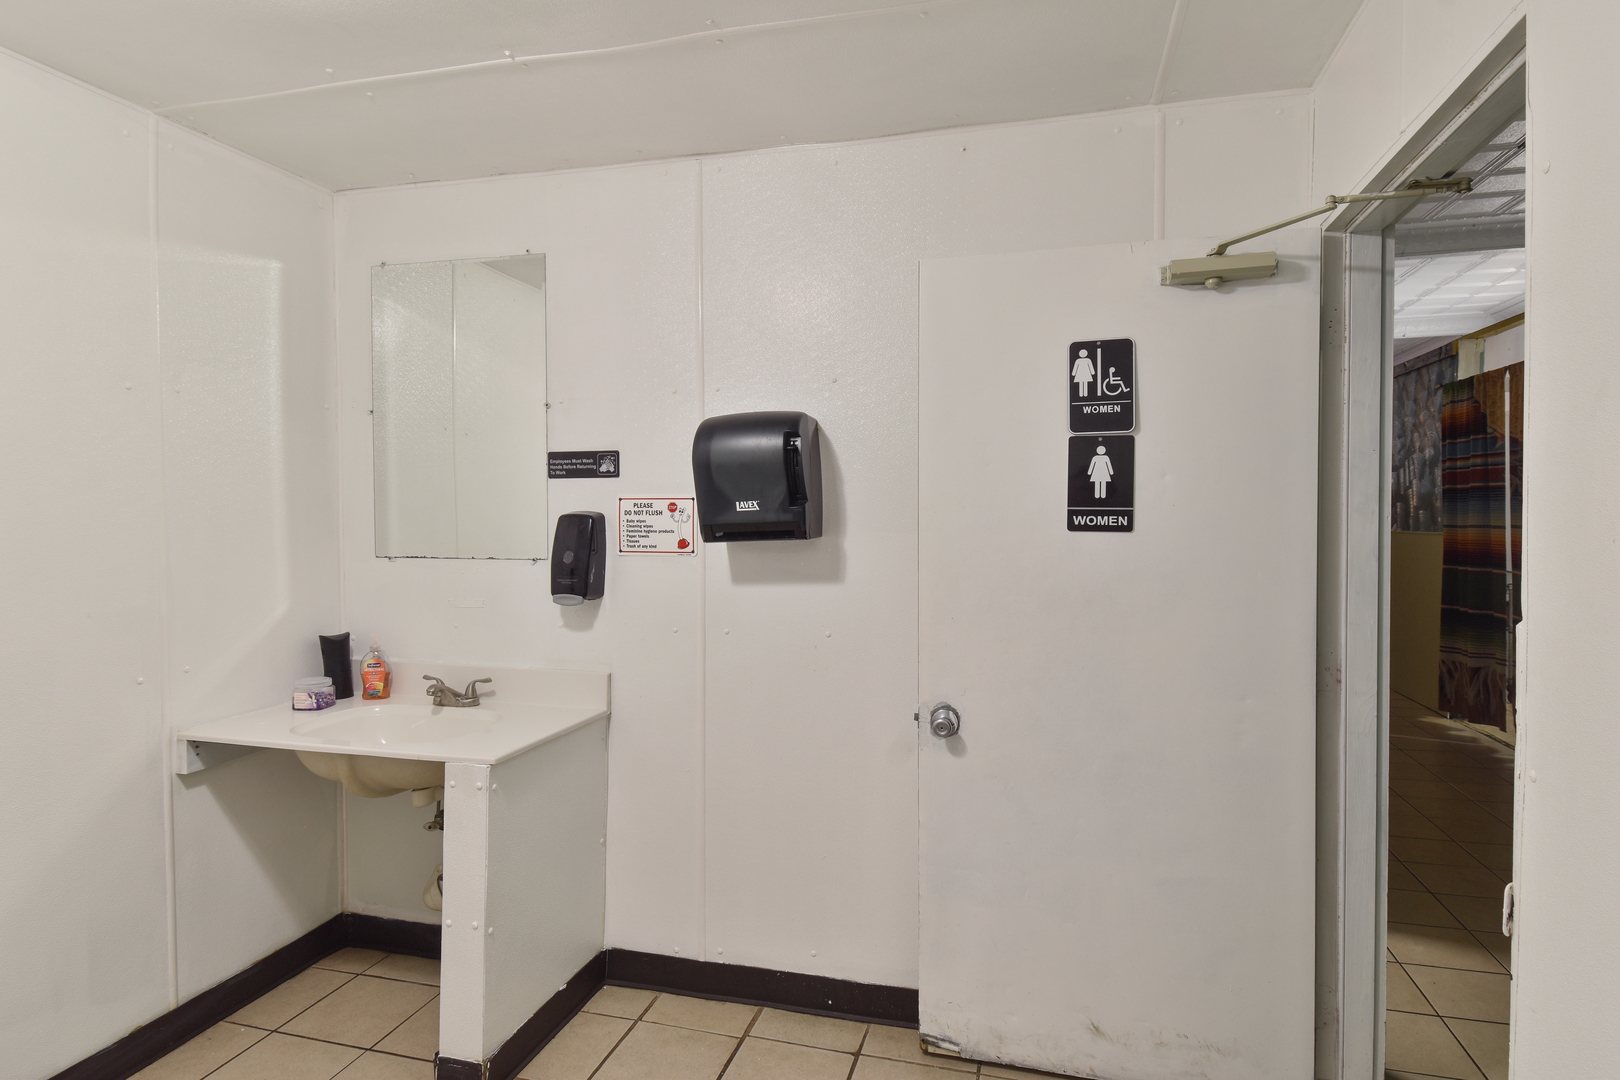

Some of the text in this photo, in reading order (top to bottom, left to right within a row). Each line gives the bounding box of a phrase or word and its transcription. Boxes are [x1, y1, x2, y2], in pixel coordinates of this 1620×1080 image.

[1083, 405, 1121, 414] WOMEN
[736, 500, 760, 511] LAVEX
[1072, 515, 1128, 526] WOMEN
